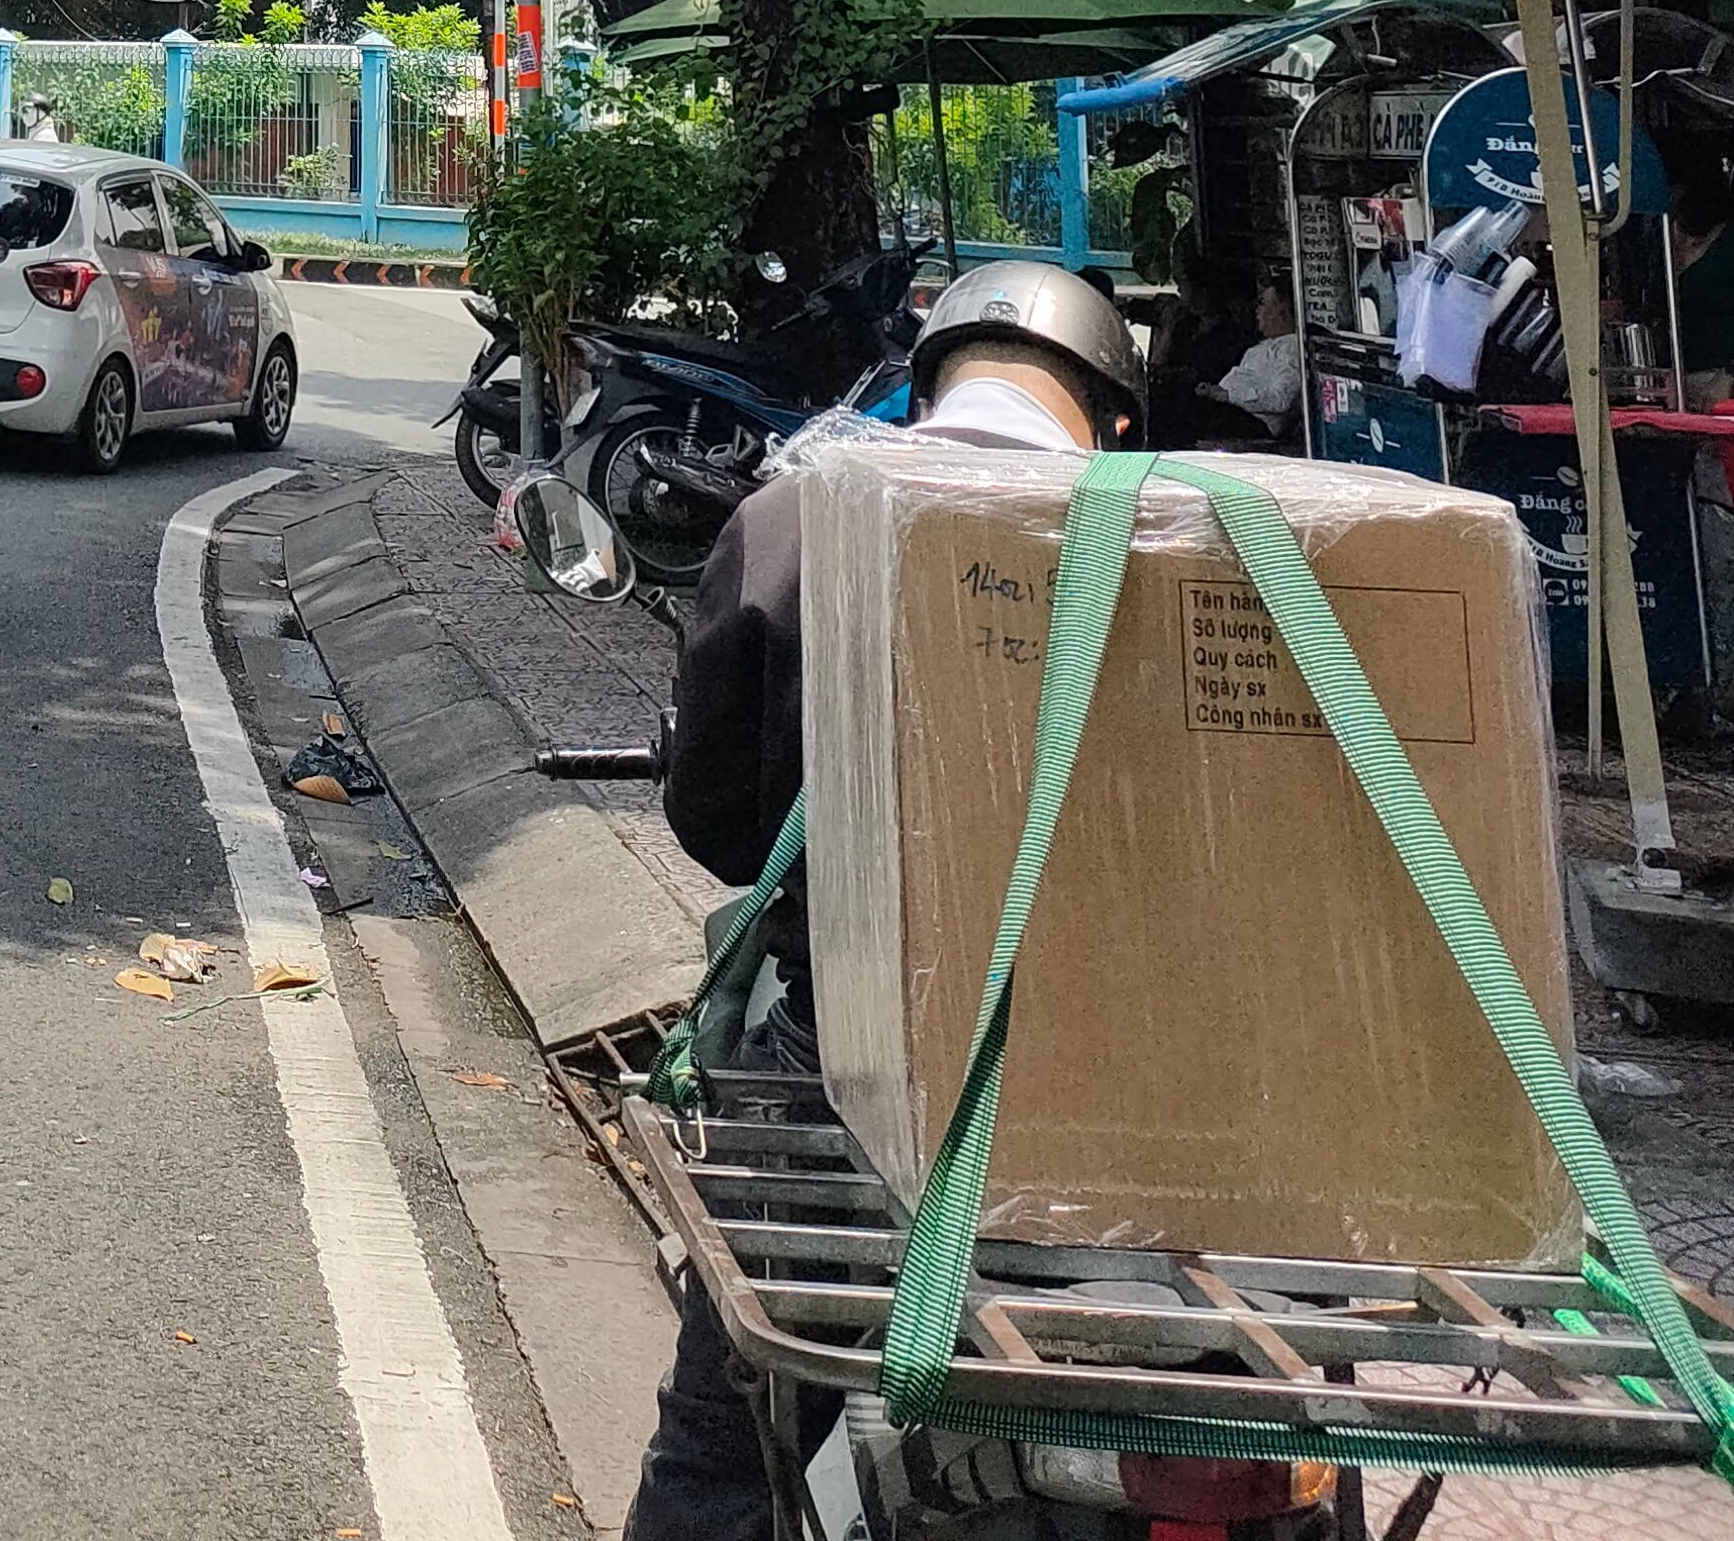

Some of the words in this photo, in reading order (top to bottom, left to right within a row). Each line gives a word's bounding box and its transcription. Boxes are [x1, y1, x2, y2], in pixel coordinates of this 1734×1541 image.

[1518, 490, 1572, 514] Đắng
[1190, 590, 1224, 610] Tên
[1230, 592, 1270, 616] hàn
[1192, 618, 1215, 638] Số
[1221, 618, 1272, 645] lượng
[1193, 646, 1228, 671] Quy
[1234, 648, 1277, 670] cách
[1195, 675, 1241, 700] Ngày
[1246, 681, 1267, 697] sx
[1196, 703, 1244, 729] Công
[1250, 706, 1296, 728] nhân
[1301, 713, 1323, 729] sx
